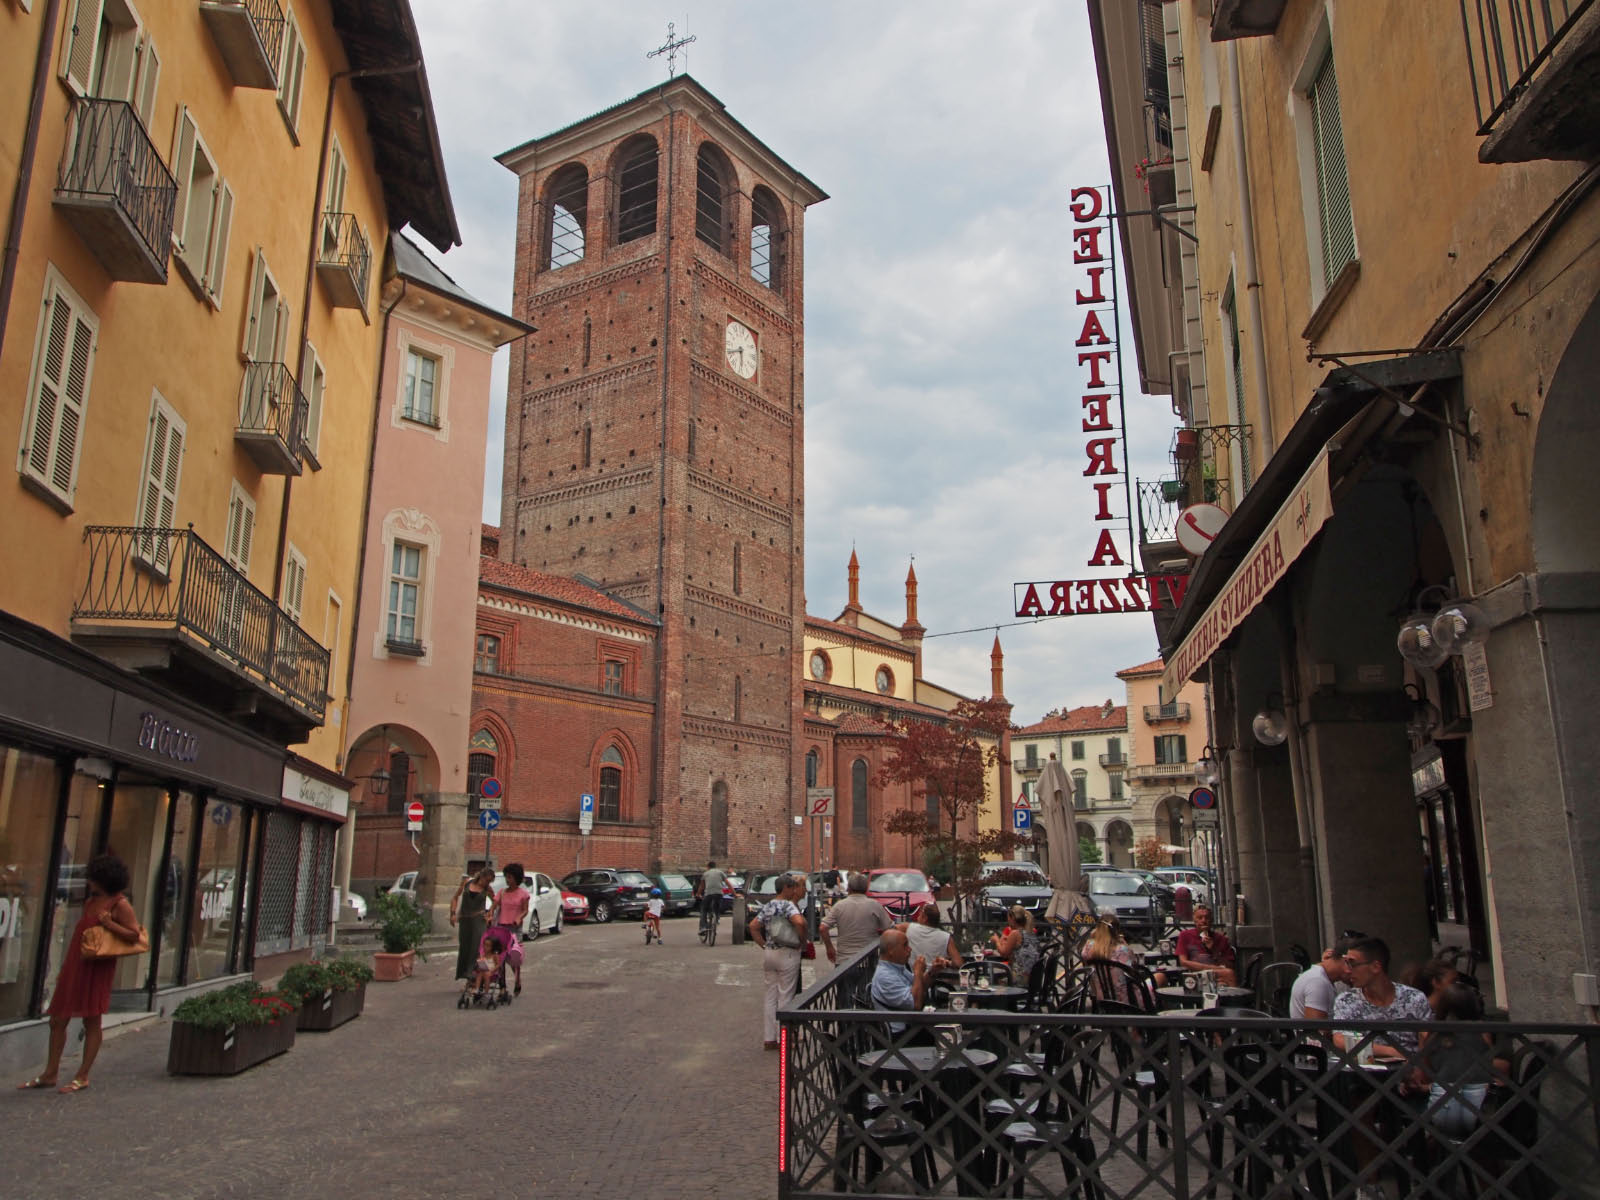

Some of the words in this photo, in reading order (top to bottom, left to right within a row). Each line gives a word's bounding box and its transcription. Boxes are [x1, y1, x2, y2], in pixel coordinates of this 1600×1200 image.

[1177, 609, 1219, 686] GELATERIA
[1220, 528, 1285, 635] SVIZZERA
[583, 796, 592, 811] P
[1016, 810, 1027, 827] P
